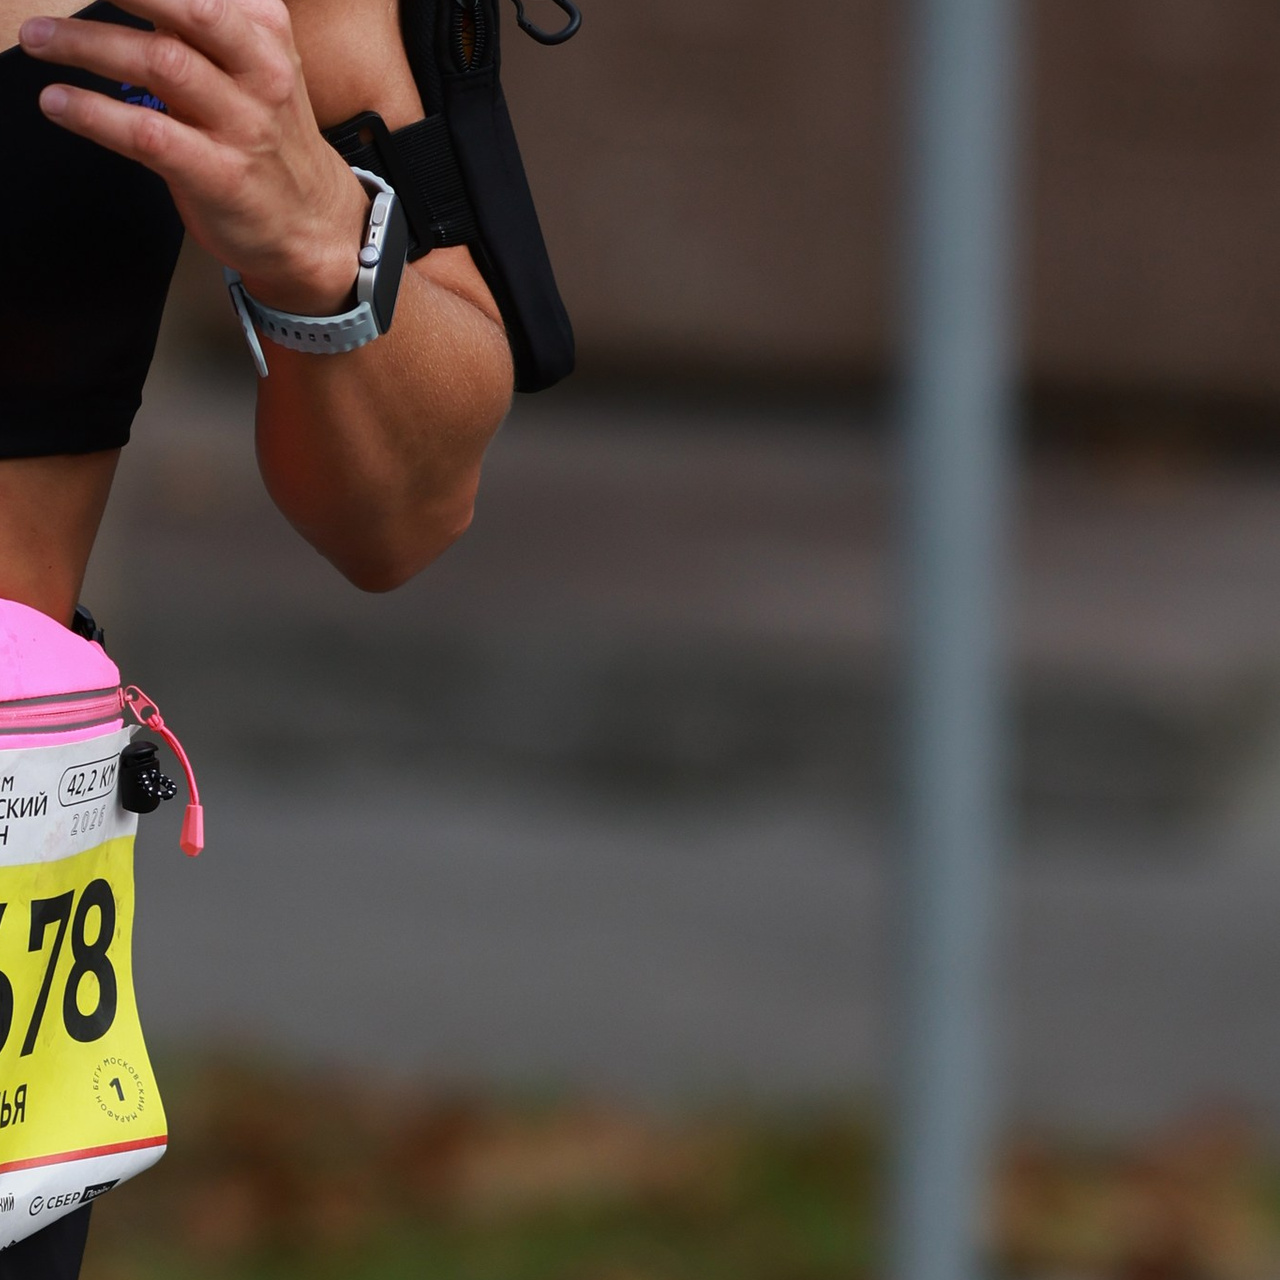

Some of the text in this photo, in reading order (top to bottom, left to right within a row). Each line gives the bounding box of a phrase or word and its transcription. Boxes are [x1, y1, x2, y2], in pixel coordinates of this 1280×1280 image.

[67, 769, 97, 797] 42,2
[109, 1077, 125, 1102] 1
[47, 1191, 81, 1210] СБЕР
